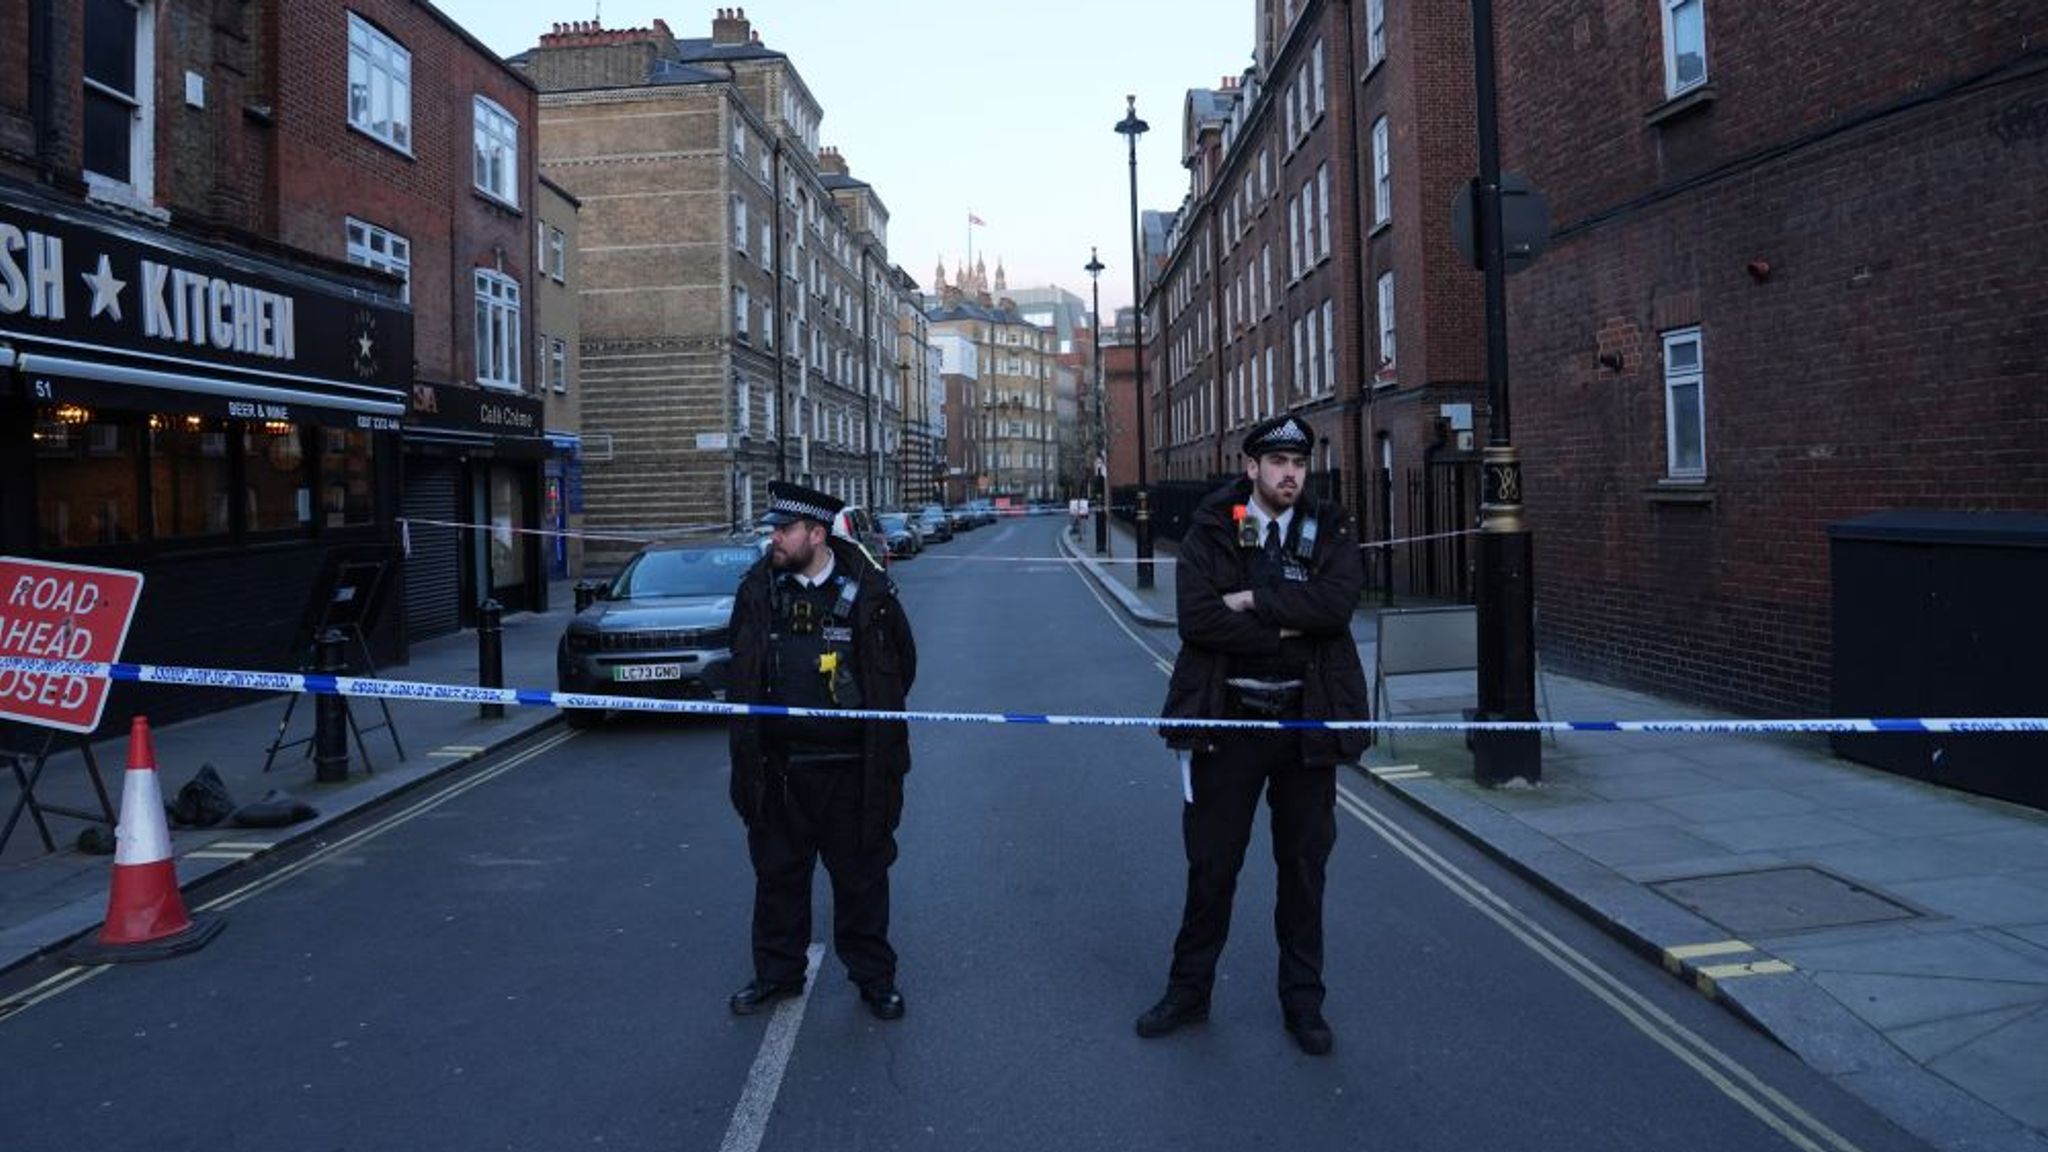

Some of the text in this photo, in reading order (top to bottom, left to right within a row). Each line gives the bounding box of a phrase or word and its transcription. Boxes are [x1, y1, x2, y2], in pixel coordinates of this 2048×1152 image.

[141, 259, 296, 360] KITCHEN
[35, 380, 52, 399] 51
[228, 401, 255, 418] BEER
[267, 405, 289, 420] WINE
[9, 575, 99, 614] ROAD
[0, 617, 92, 660] HEAD
